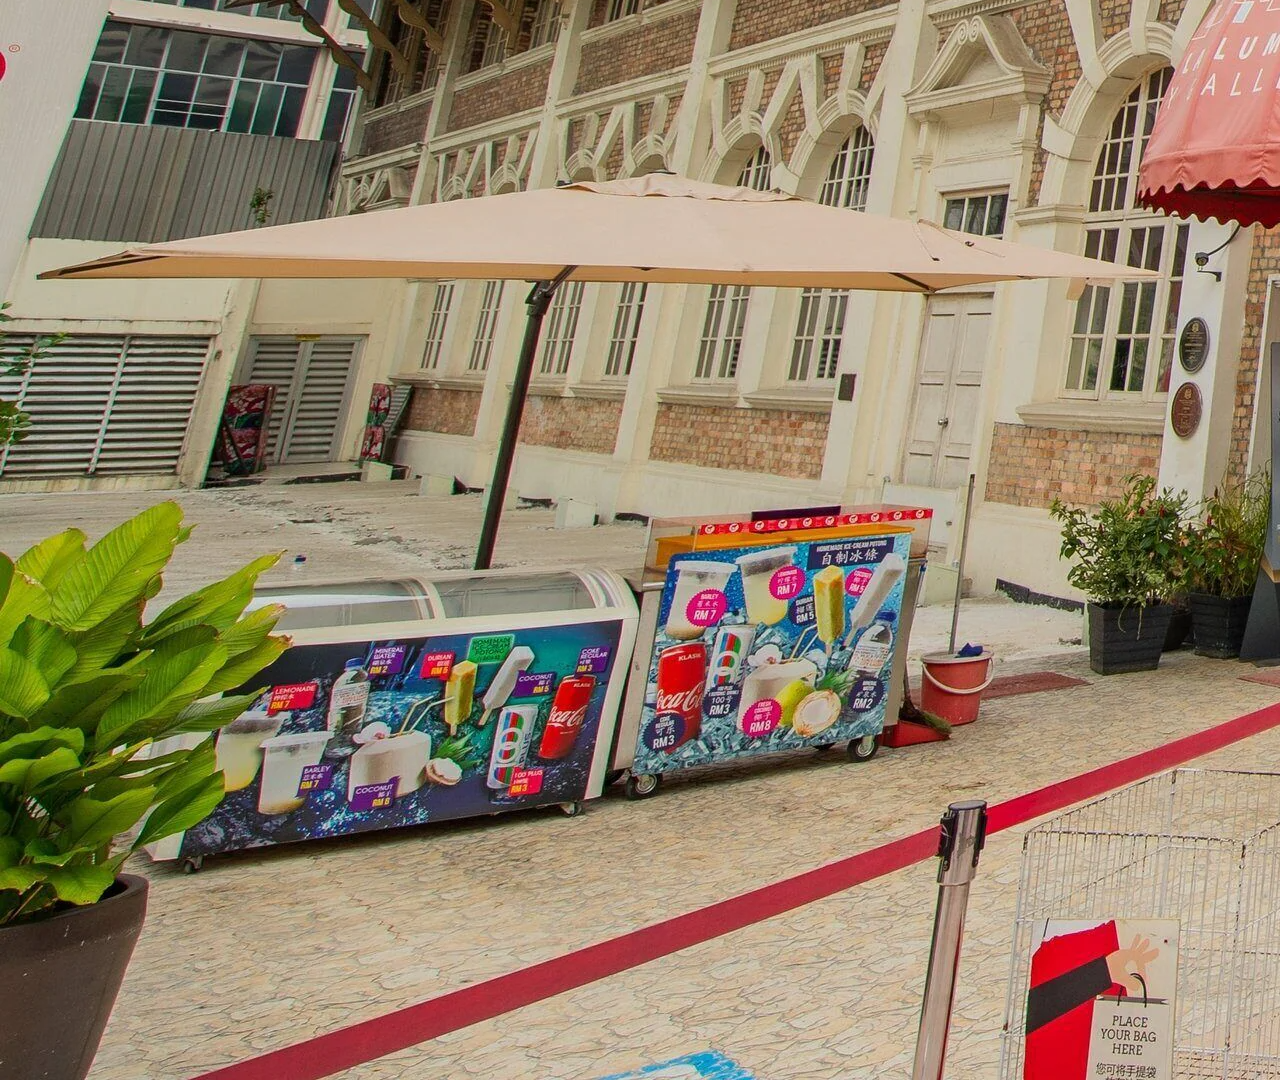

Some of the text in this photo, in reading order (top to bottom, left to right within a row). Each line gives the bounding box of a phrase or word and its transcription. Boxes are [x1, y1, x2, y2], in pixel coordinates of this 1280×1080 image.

[816, 544, 843, 553] HOMEMADE
[777, 583, 797, 596] RM 7
[848, 583, 865, 593] RM 5
[693, 609, 717, 620] RM 7
[796, 612, 815, 624] RM 5
[374, 646, 404, 655] MINERAL
[373, 652, 396, 660] WATER
[427, 653, 452, 661] DURIAN
[369, 665, 388, 675] RM 2
[430, 666, 449, 676] RM 5
[576, 664, 593, 673] RM 3
[519, 673, 553, 682] COCONUT
[275, 685, 316, 695] LEMONADE
[533, 685, 550, 694] RM 5
[270, 702, 284, 710] RM
[852, 698, 873, 709] RM2
[304, 765, 331, 775] BARLEY
[514, 769, 543, 778] 100 PLUS
[300, 780, 320, 790] RM 7
[355, 783, 394, 795] COCONUT
[510, 784, 528, 794] RM 3
[372, 799, 385, 807] RM
[1112, 1015, 1149, 1028] PLACE
[1101, 1028, 1157, 1042] YOUR BAG
[1112, 1043, 1143, 1056] HERE
[1096, 1062, 1157, 1078] 您可将手提袋
